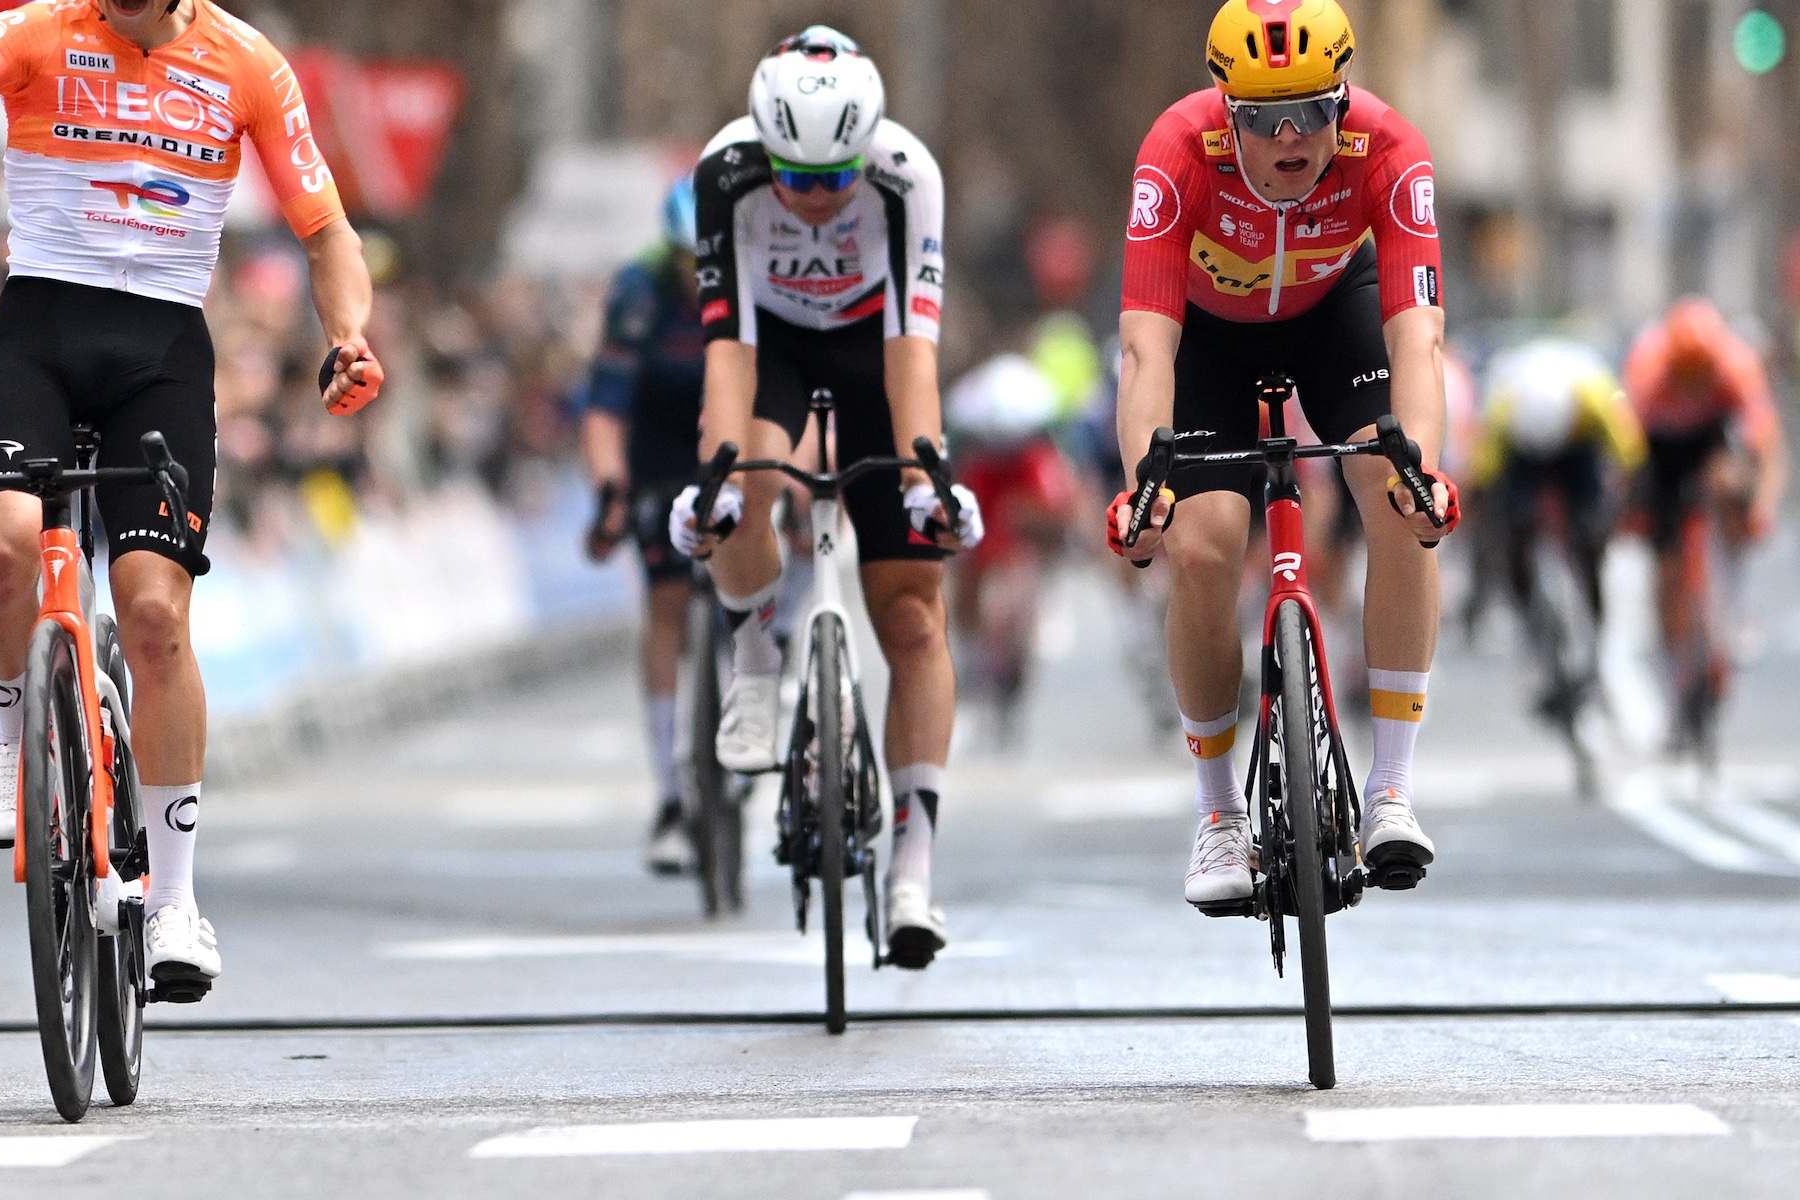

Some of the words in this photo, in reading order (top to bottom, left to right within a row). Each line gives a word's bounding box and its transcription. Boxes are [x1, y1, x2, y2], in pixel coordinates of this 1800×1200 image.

[69, 52, 110, 69] GOBIK
[55, 75, 236, 142] INEOS
[269, 61, 335, 194] INEOS
[1206, 137, 1220, 148] Uno
[1218, 190, 1268, 213] RIDLEY
[83, 210, 188, 238] TotalEnergies
[1238, 220, 1254, 231] UCI
[1238, 228, 1265, 241] WORLD
[1238, 236, 1259, 248] TEAM
[768, 256, 862, 279] UAE
[1203, 451, 1250, 462] RIDLEY
[1403, 466, 1434, 512] SRAM
[1130, 479, 1155, 532] SRAM
